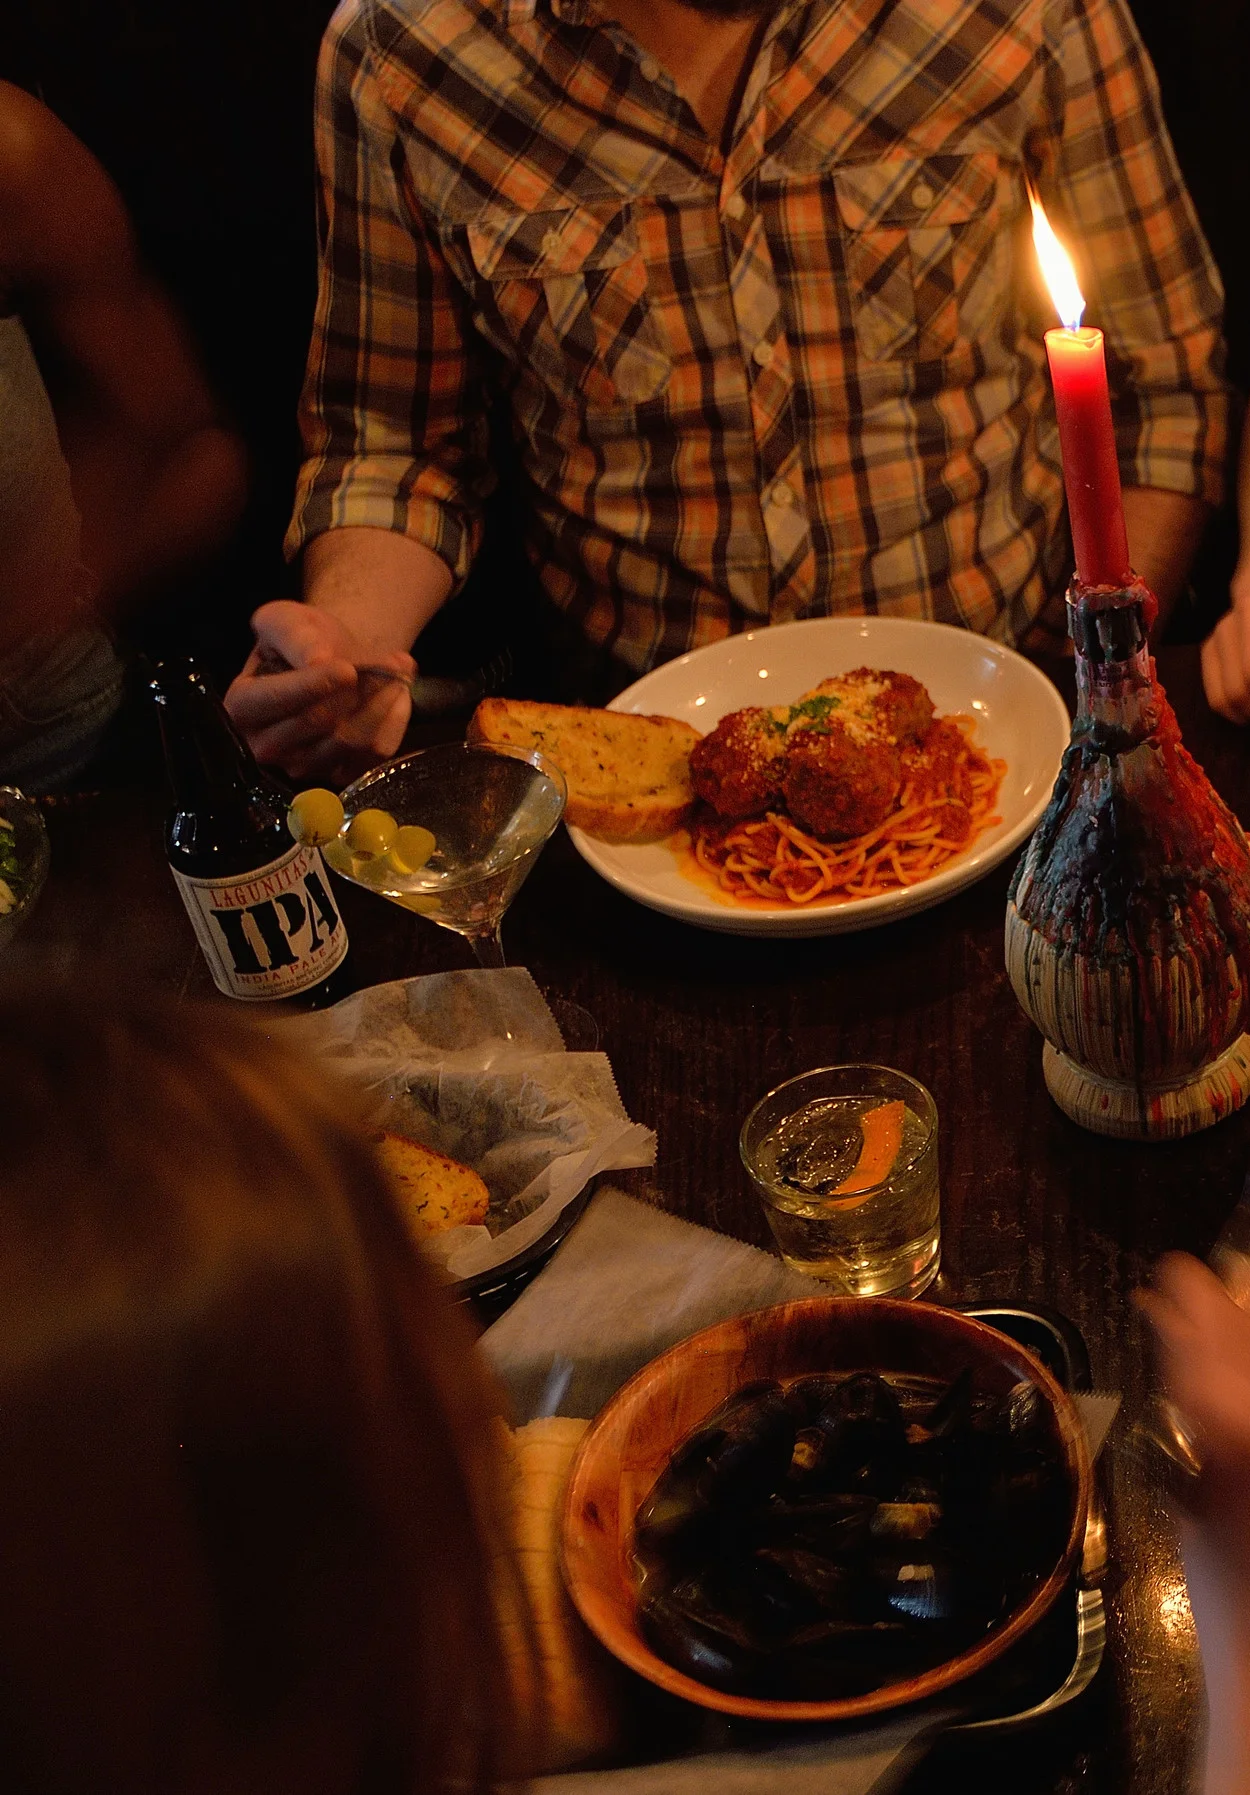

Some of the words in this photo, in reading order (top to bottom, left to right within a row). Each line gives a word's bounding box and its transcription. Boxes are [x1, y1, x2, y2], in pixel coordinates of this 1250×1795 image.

[210, 853, 308, 908] LAGUNITAS
[210, 871, 339, 974] IPA
[234, 972, 281, 984] INDIA
[289, 948, 326, 974] PALE
